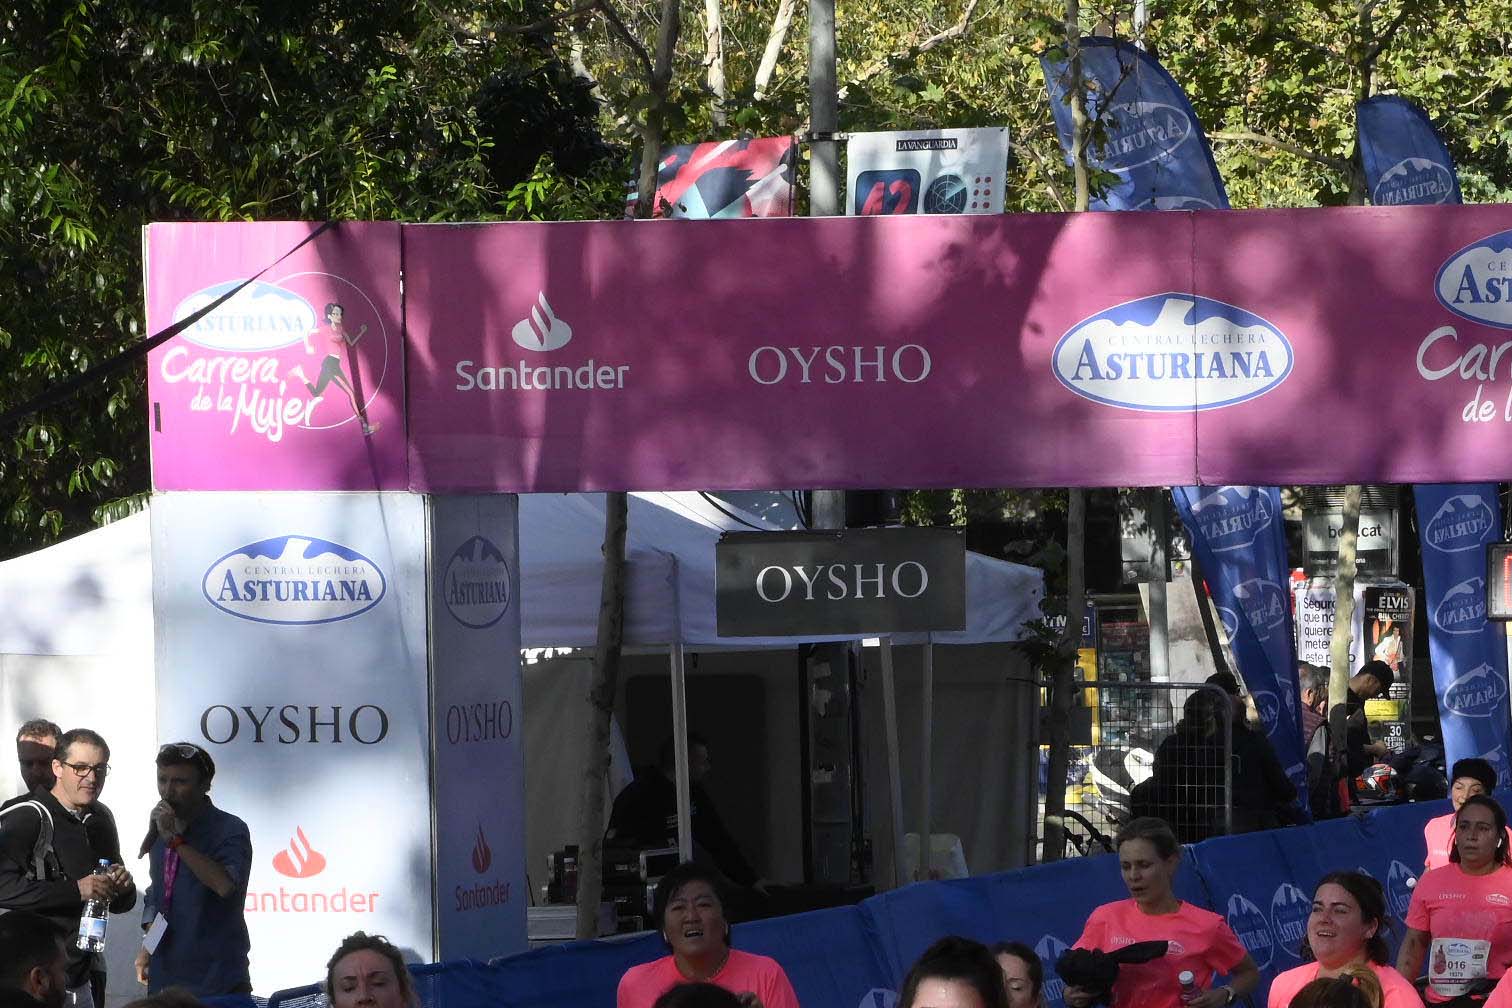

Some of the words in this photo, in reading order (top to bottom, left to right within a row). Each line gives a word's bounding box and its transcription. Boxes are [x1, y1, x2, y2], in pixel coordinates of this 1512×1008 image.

[1109, 333, 1184, 345] CENTRAL
[1191, 333, 1267, 345] LECHERA
[161, 346, 279, 384] Carrera
[456, 360, 629, 391] Santander
[748, 344, 931, 385] OYSHO
[1072, 338, 1274, 382] ASTURIANA
[191, 387, 211, 411] de
[217, 384, 233, 411] la
[230, 380, 323, 442] Mujer
[1462, 384, 1496, 422] de
[217, 568, 373, 602] ASTURIANA
[308, 566, 367, 576] LECHERA
[756, 560, 928, 603] OYSHO
[450, 580, 507, 605] ASTURIANA
[1379, 596, 1409, 609] ELVIS
[1305, 626, 1333, 638] quiere
[200, 704, 389, 745] OYSHO
[446, 701, 513, 744] OYSHO
[1389, 725, 1402, 737] 30
[245, 888, 379, 913] antander
[455, 881, 511, 913] Santander
[1447, 960, 1467, 970] 016
